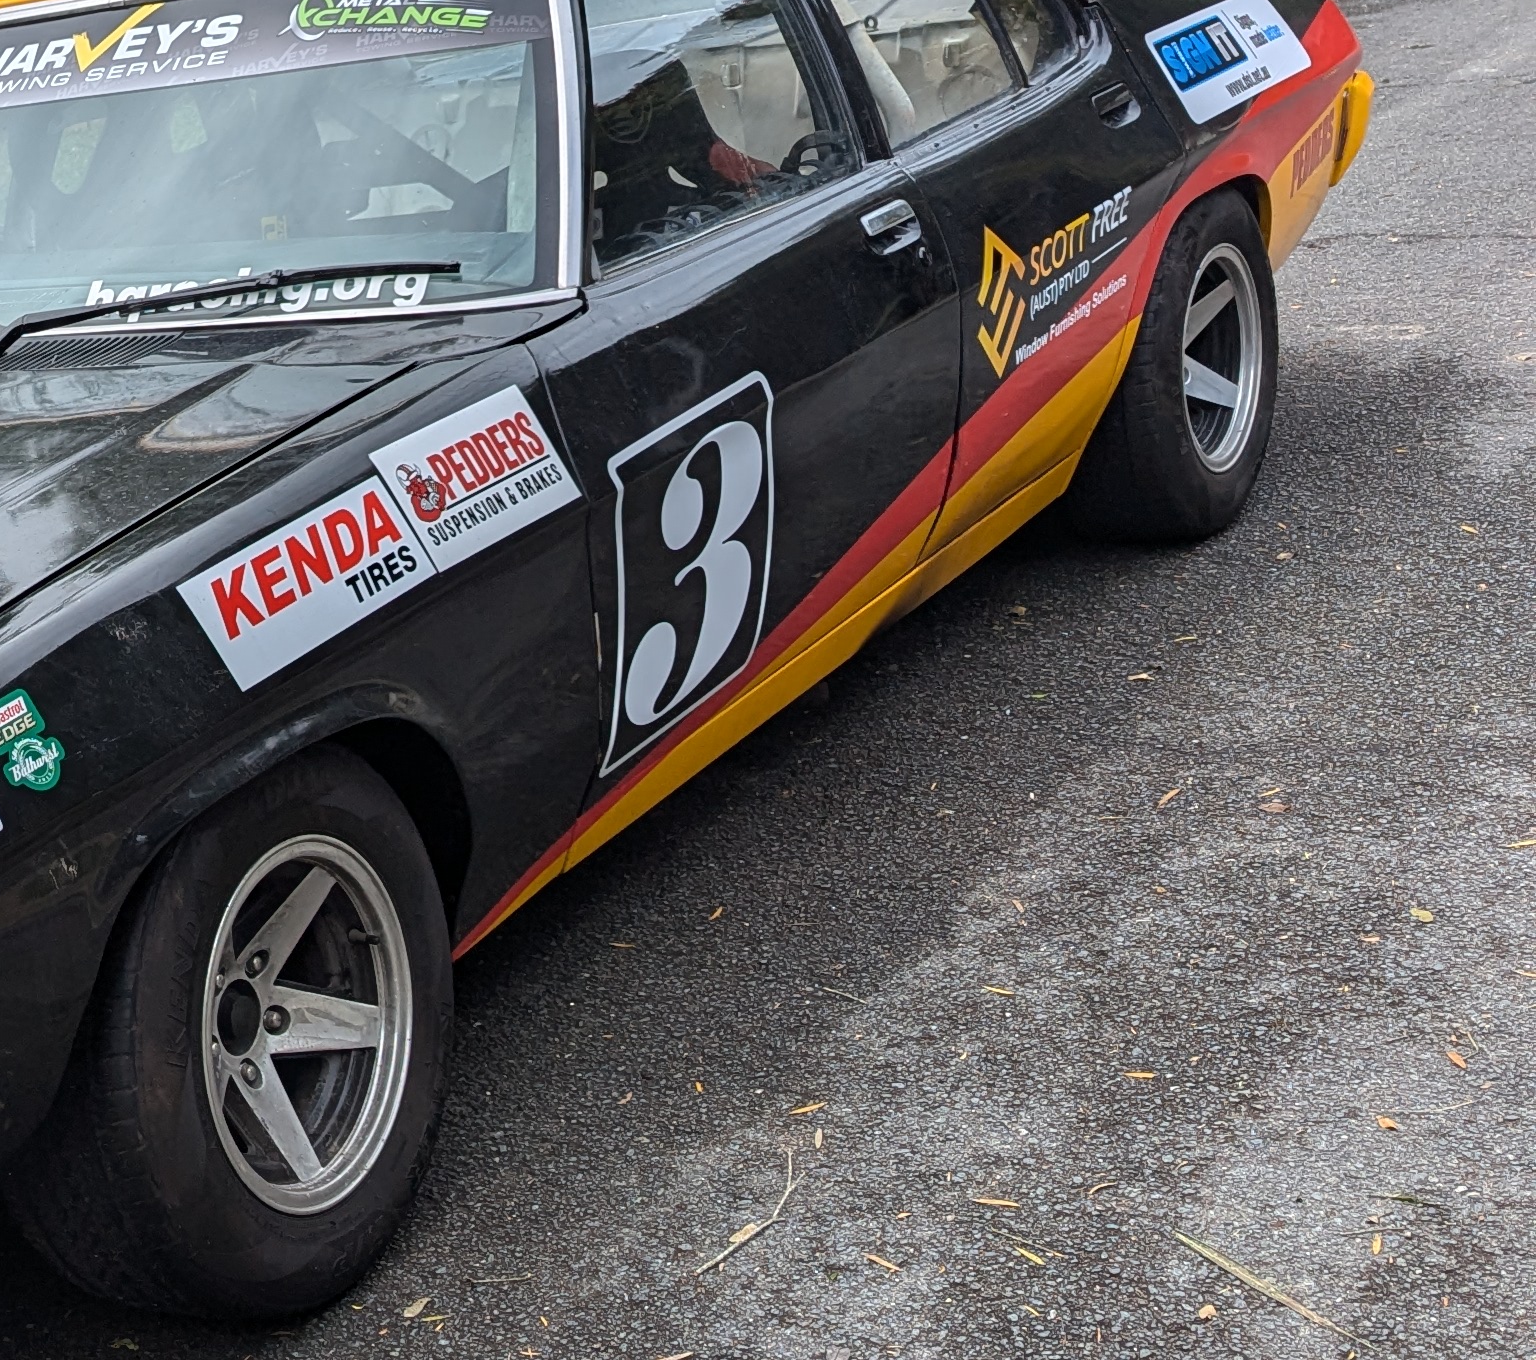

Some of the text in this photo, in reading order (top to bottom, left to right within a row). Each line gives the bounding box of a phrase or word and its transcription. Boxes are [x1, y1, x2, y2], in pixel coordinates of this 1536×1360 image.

[85, 50, 229, 82] SERVICE
[1161, 22, 1239, 83] SIGN IT
[1030, 186, 1132, 286] SCOTT FREE
[1015, 274, 1127, 365] Window Furnishing Solutions
[1030, 260, 1090, 321] (AUST) PTY LTD
[426, 412, 545, 500] PEDDERS
[428, 464, 563, 546] SUSPENSION & BRAKES
[210, 491, 402, 641] KENDA
[345, 546, 417, 604] TIRES
[625, 421, 763, 726] 3
[8, 742, 59, 782] Bathurst
